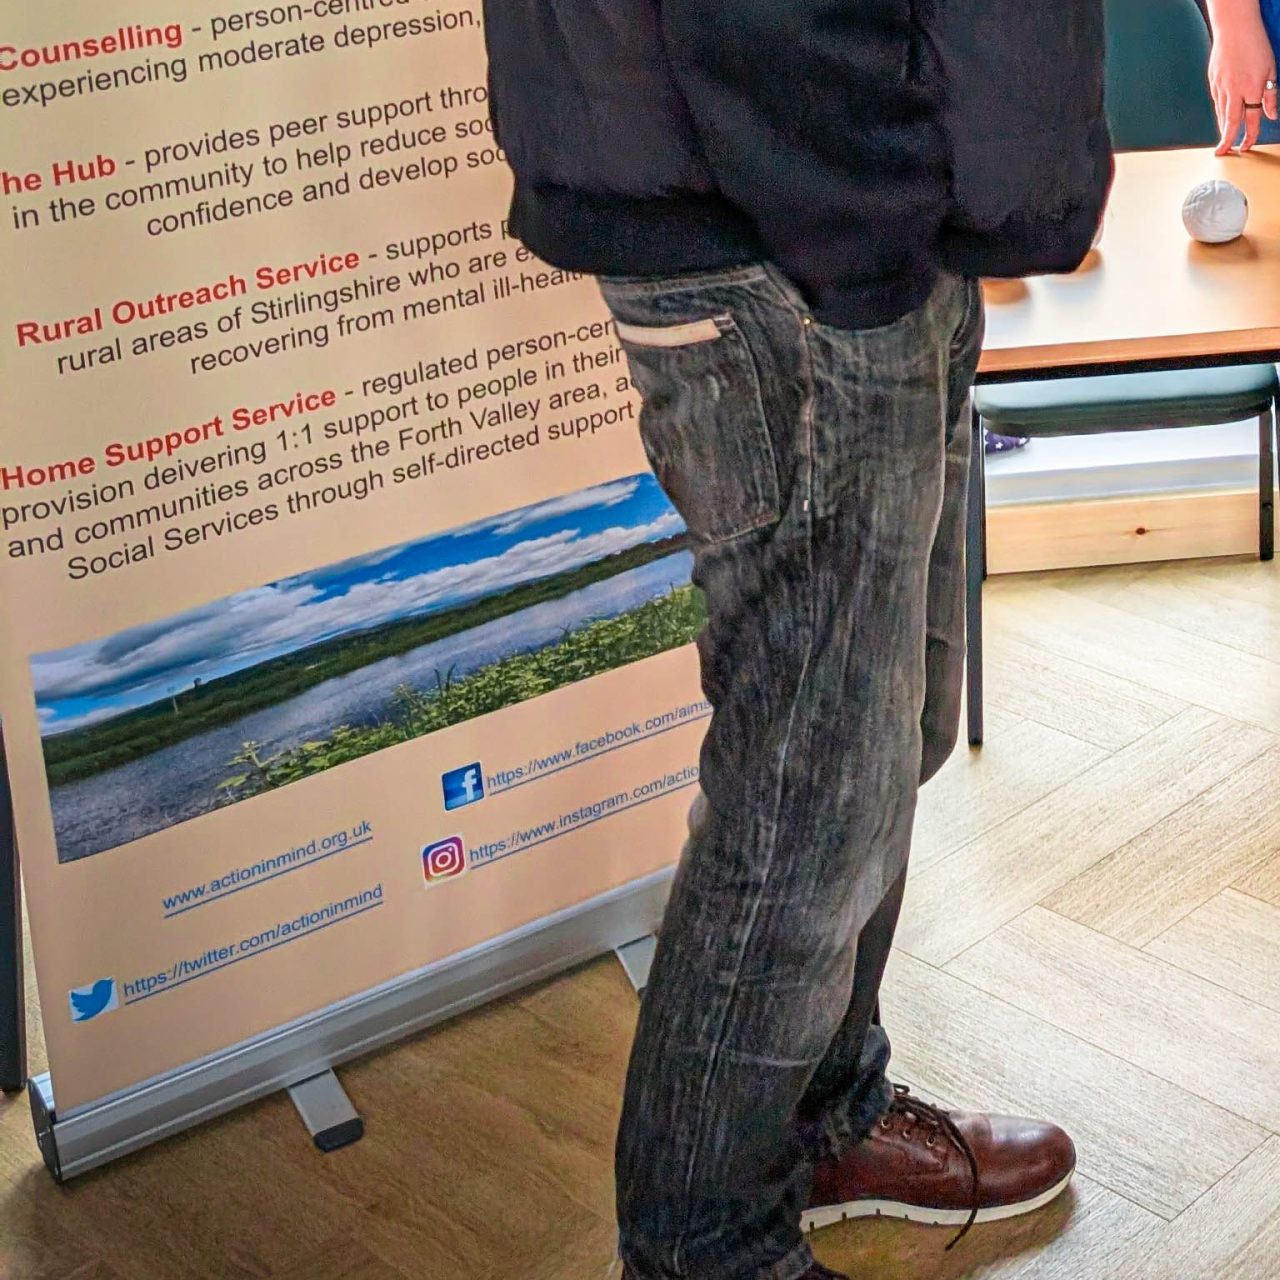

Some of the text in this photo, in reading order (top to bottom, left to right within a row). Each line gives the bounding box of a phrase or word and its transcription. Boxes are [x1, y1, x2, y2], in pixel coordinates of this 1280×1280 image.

[0, 24, 182, 70] Counselling
[2, 10, 480, 107] experiencing moderate depression,
[2, 172, 41, 195] he
[52, 154, 115, 186] Hub
[145, 129, 260, 173] provides
[269, 115, 328, 147] peer
[337, 91, 433, 128] support
[14, 126, 446, 229] in the community to help reduce
[147, 156, 458, 235] confidence and develop
[17, 222, 492, 347] Rural Outreach Service supports
[58, 252, 507, 374] rural areas of Stirlingshire who are
[191, 282, 485, 374] recovering from mental
[0, 348, 477, 490] Home Support Service regulated
[2, 480, 134, 530] provision
[144, 441, 266, 490] deivering
[277, 423, 311, 451] 1:1
[324, 396, 419, 439] support
[425, 392, 449, 411] to
[458, 368, 537, 409] people
[545, 360, 565, 381] in
[8, 384, 607, 558] and communities across the Forth Valley area,
[68, 401, 634, 579] Social Services through self-directed support
[162, 820, 371, 910] www.actioninmind.org.uk
[124, 883, 383, 998] https://twitter.com/actioninmind
